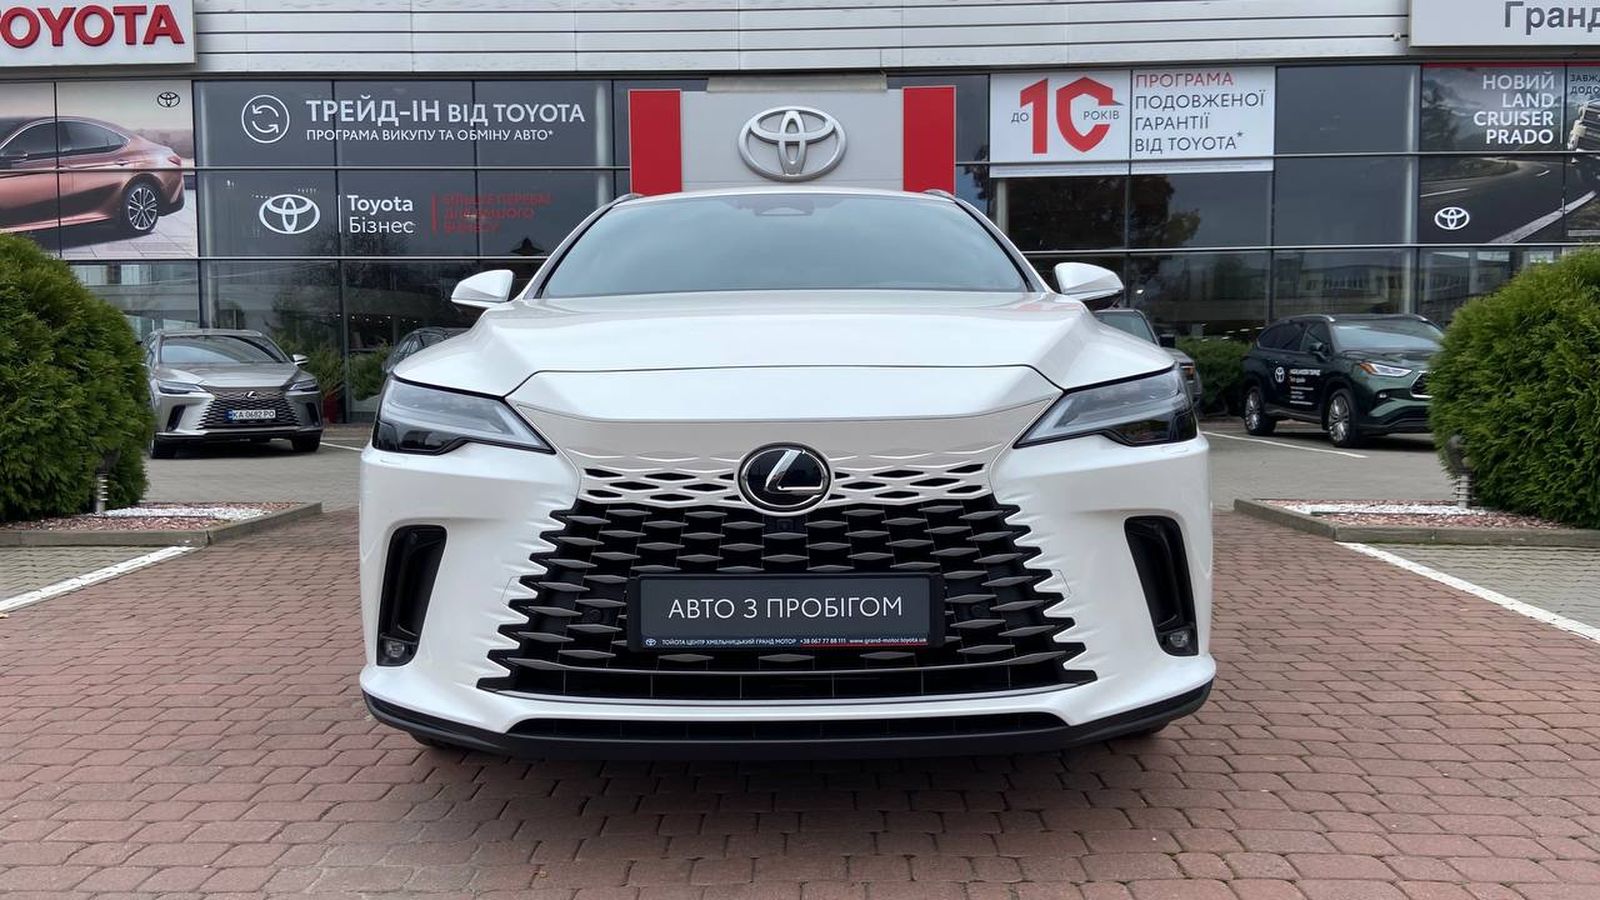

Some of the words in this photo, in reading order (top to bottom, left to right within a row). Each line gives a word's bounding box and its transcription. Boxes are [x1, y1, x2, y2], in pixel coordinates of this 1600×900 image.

[0, 5, 185, 48] OYOTA
[1136, 72, 1233, 88] ПРОГРАМА
[1483, 71, 1554, 89] НОВИЙ
[1570, 74, 1600, 82] ЗАВЖ
[1136, 90, 1266, 110] ПОДОВЖЕНОЇ
[1502, 93, 1554, 107] LAND
[449, 103, 488, 126] ВІД
[494, 104, 585, 122] TOYOTA
[1011, 113, 1029, 123] ДО
[1083, 110, 1119, 121] РОКІВ
[1135, 112, 1210, 131] ГАРАНТІЇ
[1474, 111, 1554, 126] CRUISER
[306, 130, 379, 141] ПРОГРАМА
[383, 130, 434, 141] ВИКУПУ
[439, 130, 455, 140] ТА
[457, 130, 510, 141] ОБМІНУ
[1486, 129, 1553, 144] PRADO
[1136, 138, 1163, 154] ВІД
[347, 195, 413, 215] Toyota
[350, 217, 414, 233] Бізнес
[669, 599, 735, 618] АВТО
[743, 599, 757, 618] З
[767, 597, 902, 618] ПРОБІГОМ
